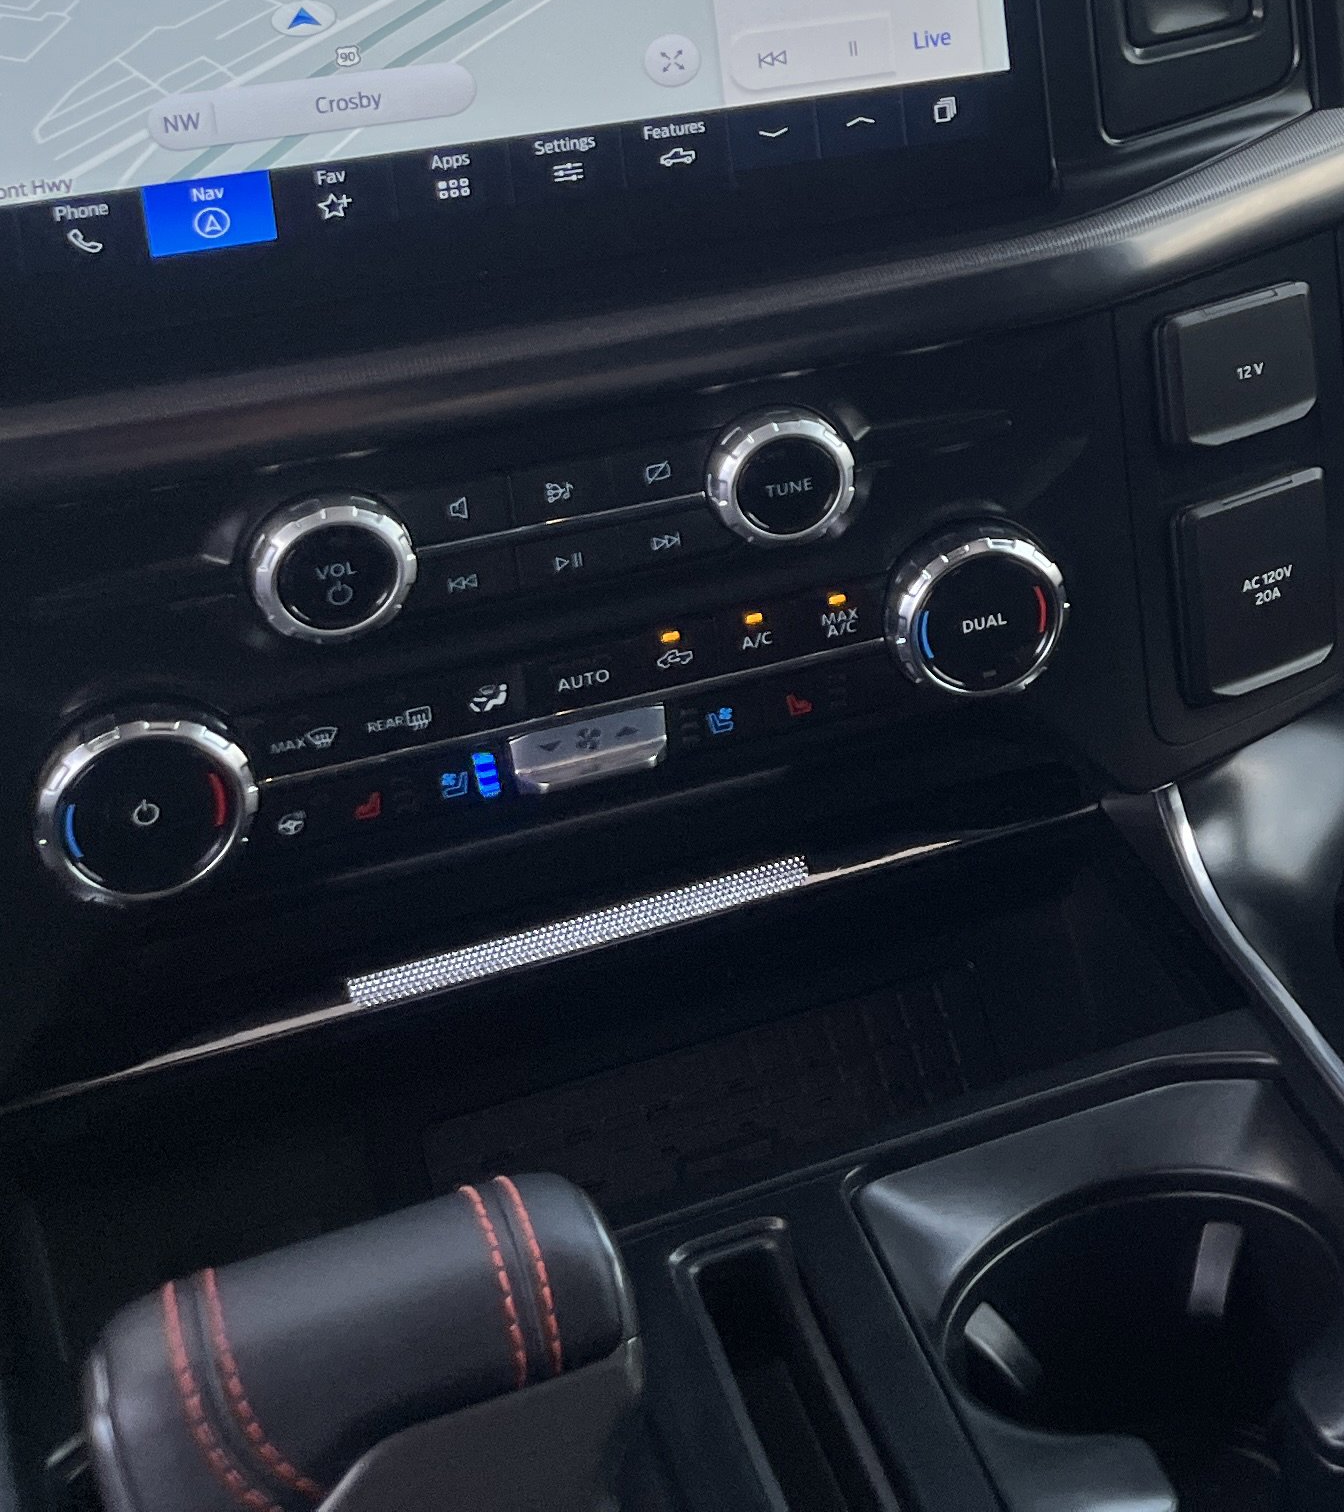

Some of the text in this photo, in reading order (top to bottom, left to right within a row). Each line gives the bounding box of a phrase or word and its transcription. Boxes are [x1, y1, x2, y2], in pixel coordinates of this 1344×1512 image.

[912, 30, 952, 50] Live
[339, 51, 356, 63] 90
[314, 91, 382, 115] Crosby
[162, 111, 201, 134] NW
[642, 118, 707, 141] Features
[533, 134, 597, 157] Settings
[430, 151, 471, 171] Apps
[31, 177, 74, 194] Hwy
[316, 168, 346, 186] Fav
[192, 185, 225, 203] Nav
[52, 202, 110, 223] Phone
[765, 476, 814, 499] TUNE
[314, 561, 358, 580] VOL
[1242, 564, 1293, 593] AC 120V
[1255, 586, 1281, 606] 20A
[821, 606, 860, 627] MAX
[961, 612, 1008, 634] DUAL
[826, 619, 857, 639] A/C
[742, 630, 774, 651] A/C
[557, 669, 611, 694] AUTO
[367, 715, 404, 734] REAR
[270, 737, 307, 755] MAX
